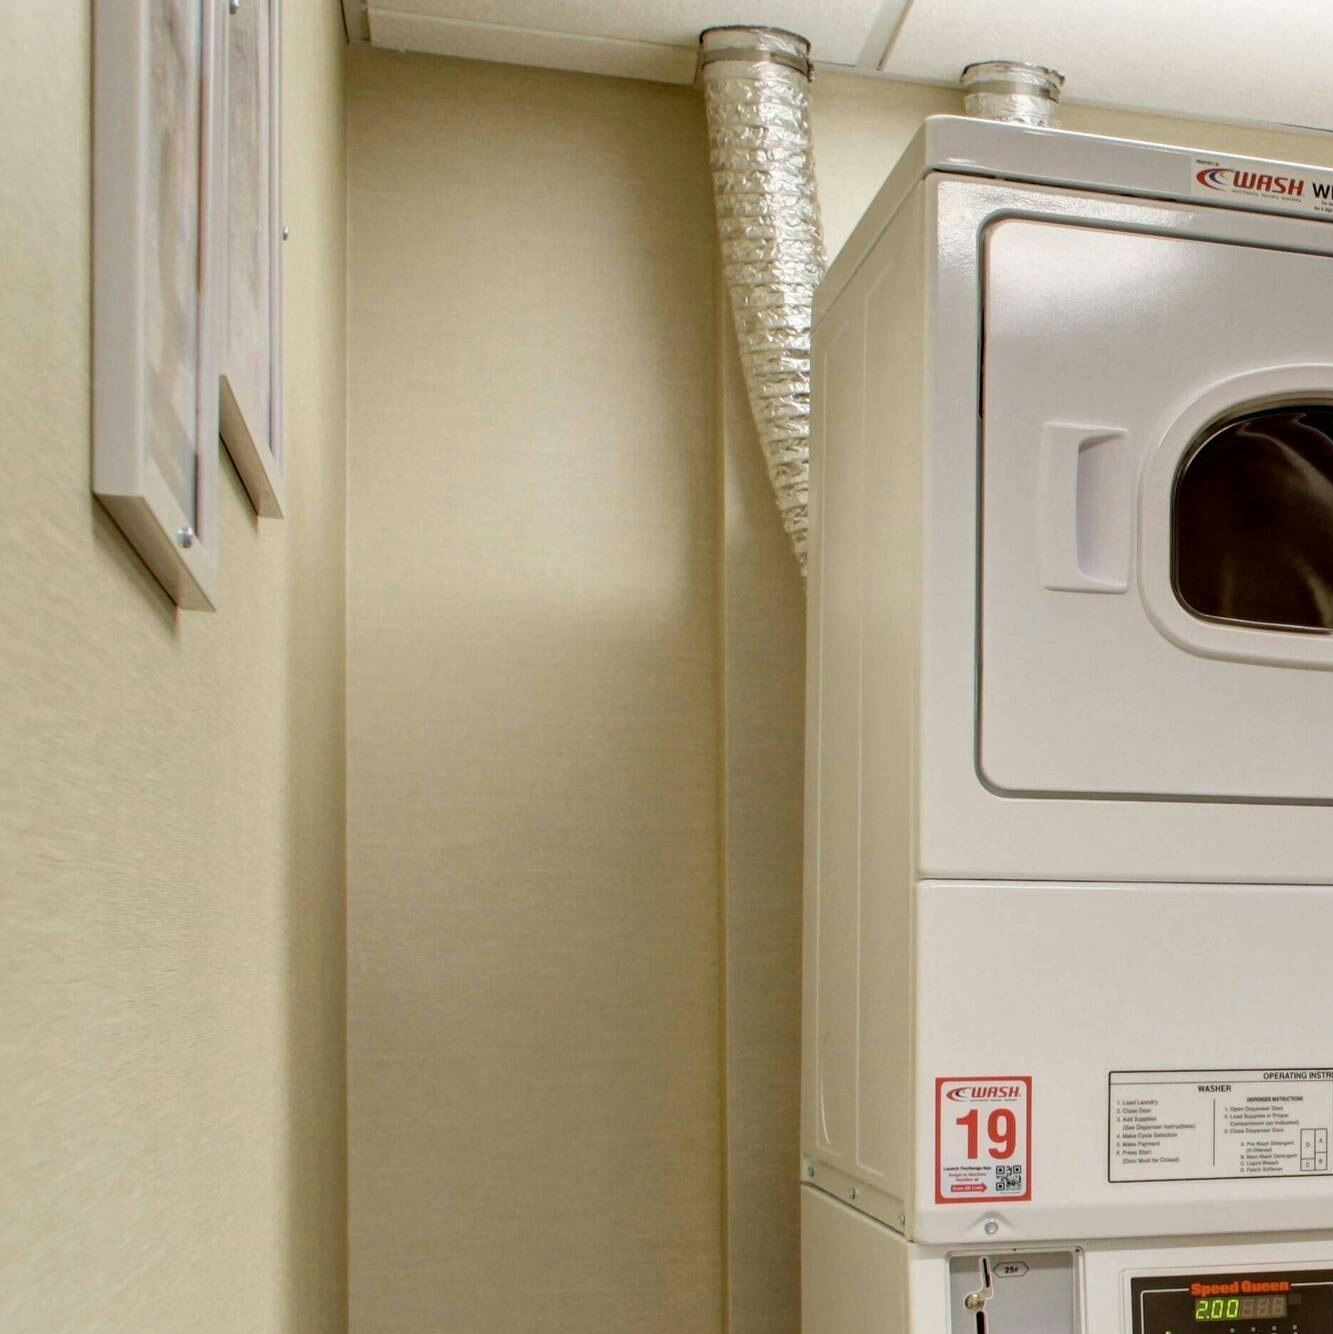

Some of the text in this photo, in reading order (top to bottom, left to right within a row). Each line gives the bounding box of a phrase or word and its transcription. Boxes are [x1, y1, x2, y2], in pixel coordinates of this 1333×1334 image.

[1232, 170, 1305, 197] WASH
[1263, 1072, 1307, 1080] OPERATING
[971, 1086, 1020, 1098] WASH
[1198, 1084, 1232, 1093] WASHER
[956, 1108, 1016, 1160] 19
[1191, 1280, 1289, 1297] Speed Queen
[1195, 1299, 1239, 1319] 2.00
